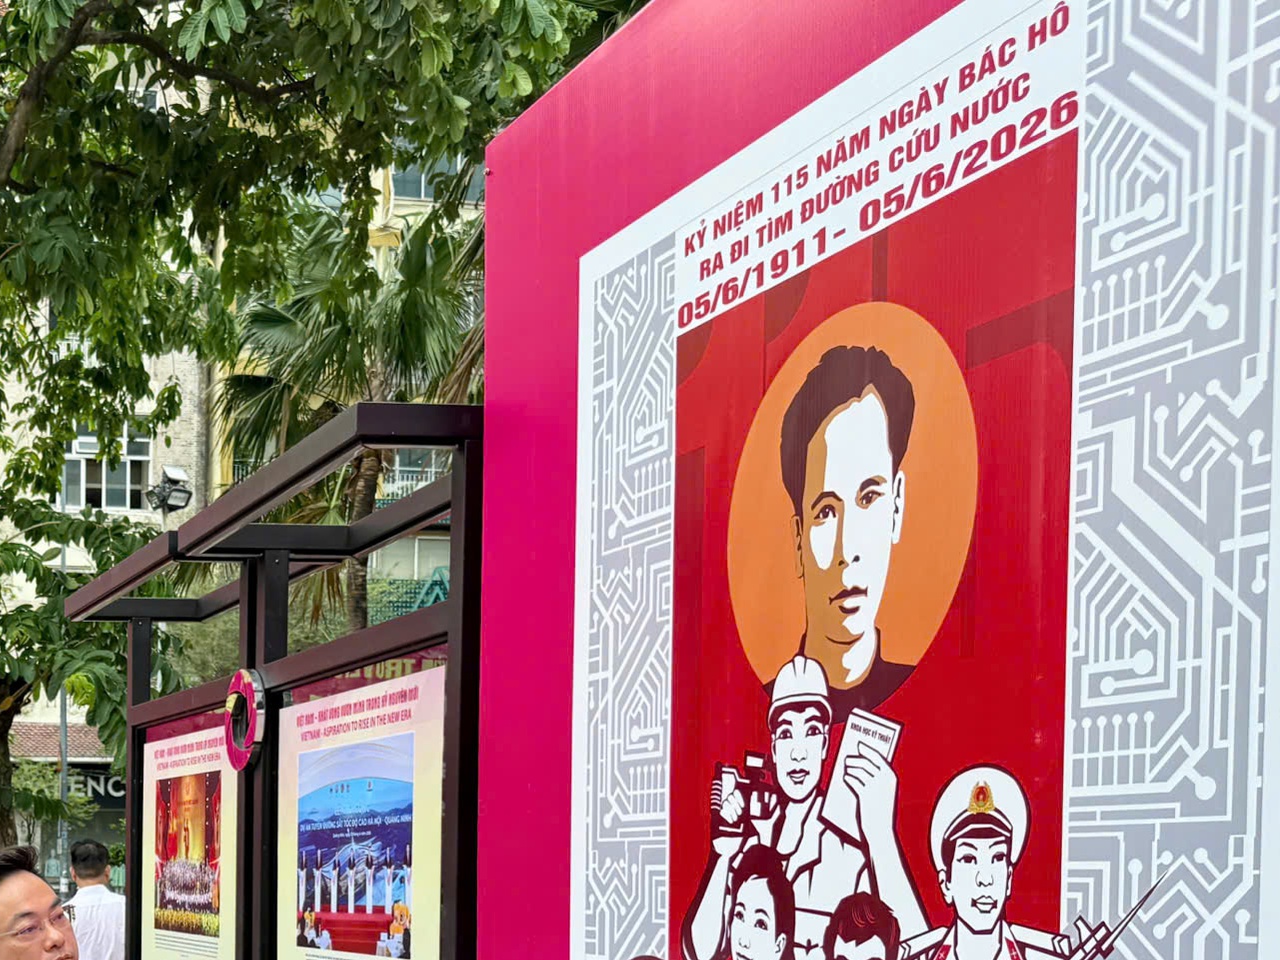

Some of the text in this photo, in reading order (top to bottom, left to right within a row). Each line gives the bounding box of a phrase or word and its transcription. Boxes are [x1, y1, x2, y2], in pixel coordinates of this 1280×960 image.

[684, 219, 707, 257] KỶ
[713, 192, 763, 240] NIỆM
[771, 164, 808, 204] 115
[816, 125, 870, 178] NĂM
[879, 76, 949, 141] NGÀY
[959, 37, 1016, 93] BÁC
[699, 72, 1030, 281] RA ĐI TÌM ĐƯỜNG CỨU NƯỚC
[859, 90, 1078, 232] 05/6/2026
